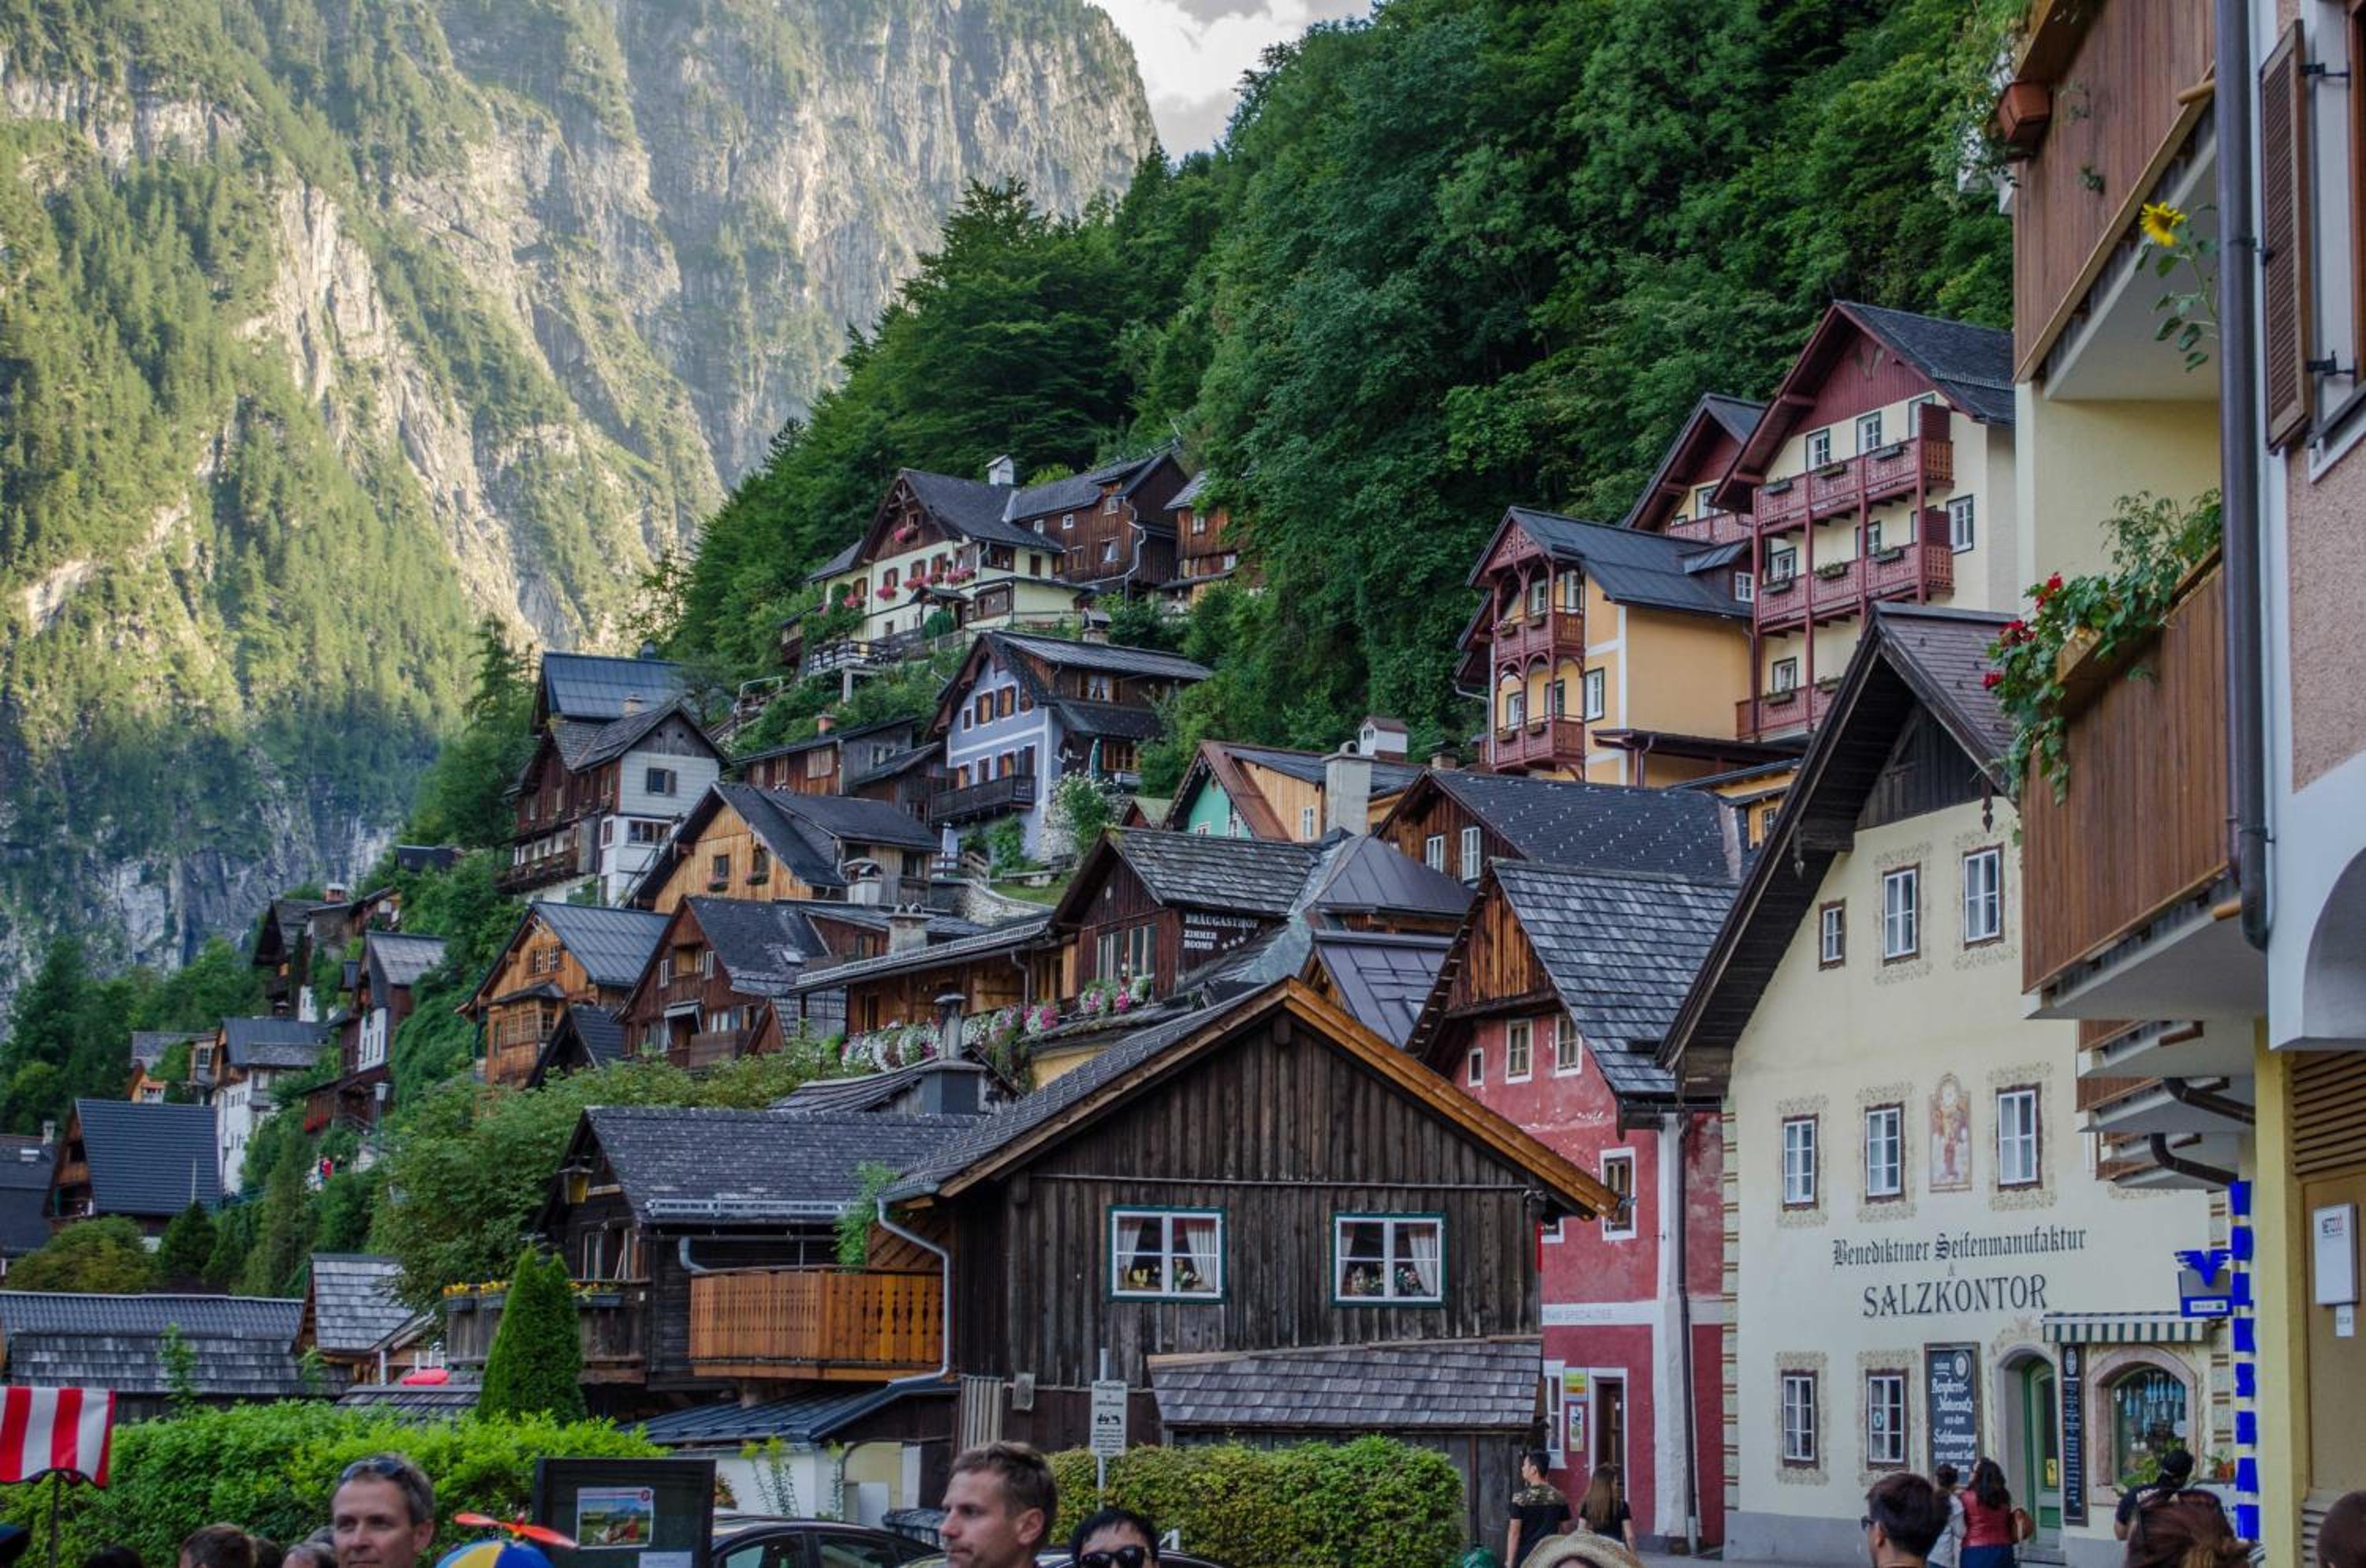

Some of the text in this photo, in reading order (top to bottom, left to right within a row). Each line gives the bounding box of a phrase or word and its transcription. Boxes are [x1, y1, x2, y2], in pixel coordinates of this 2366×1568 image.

[1184, 939, 1214, 950] ROOMS
[1185, 930, 1217, 940] ZIMMER
[1832, 1224, 2087, 1271] Benediktiner Seifenmanufaktur
[1862, 1274, 2047, 1319] SALZKONTOR
